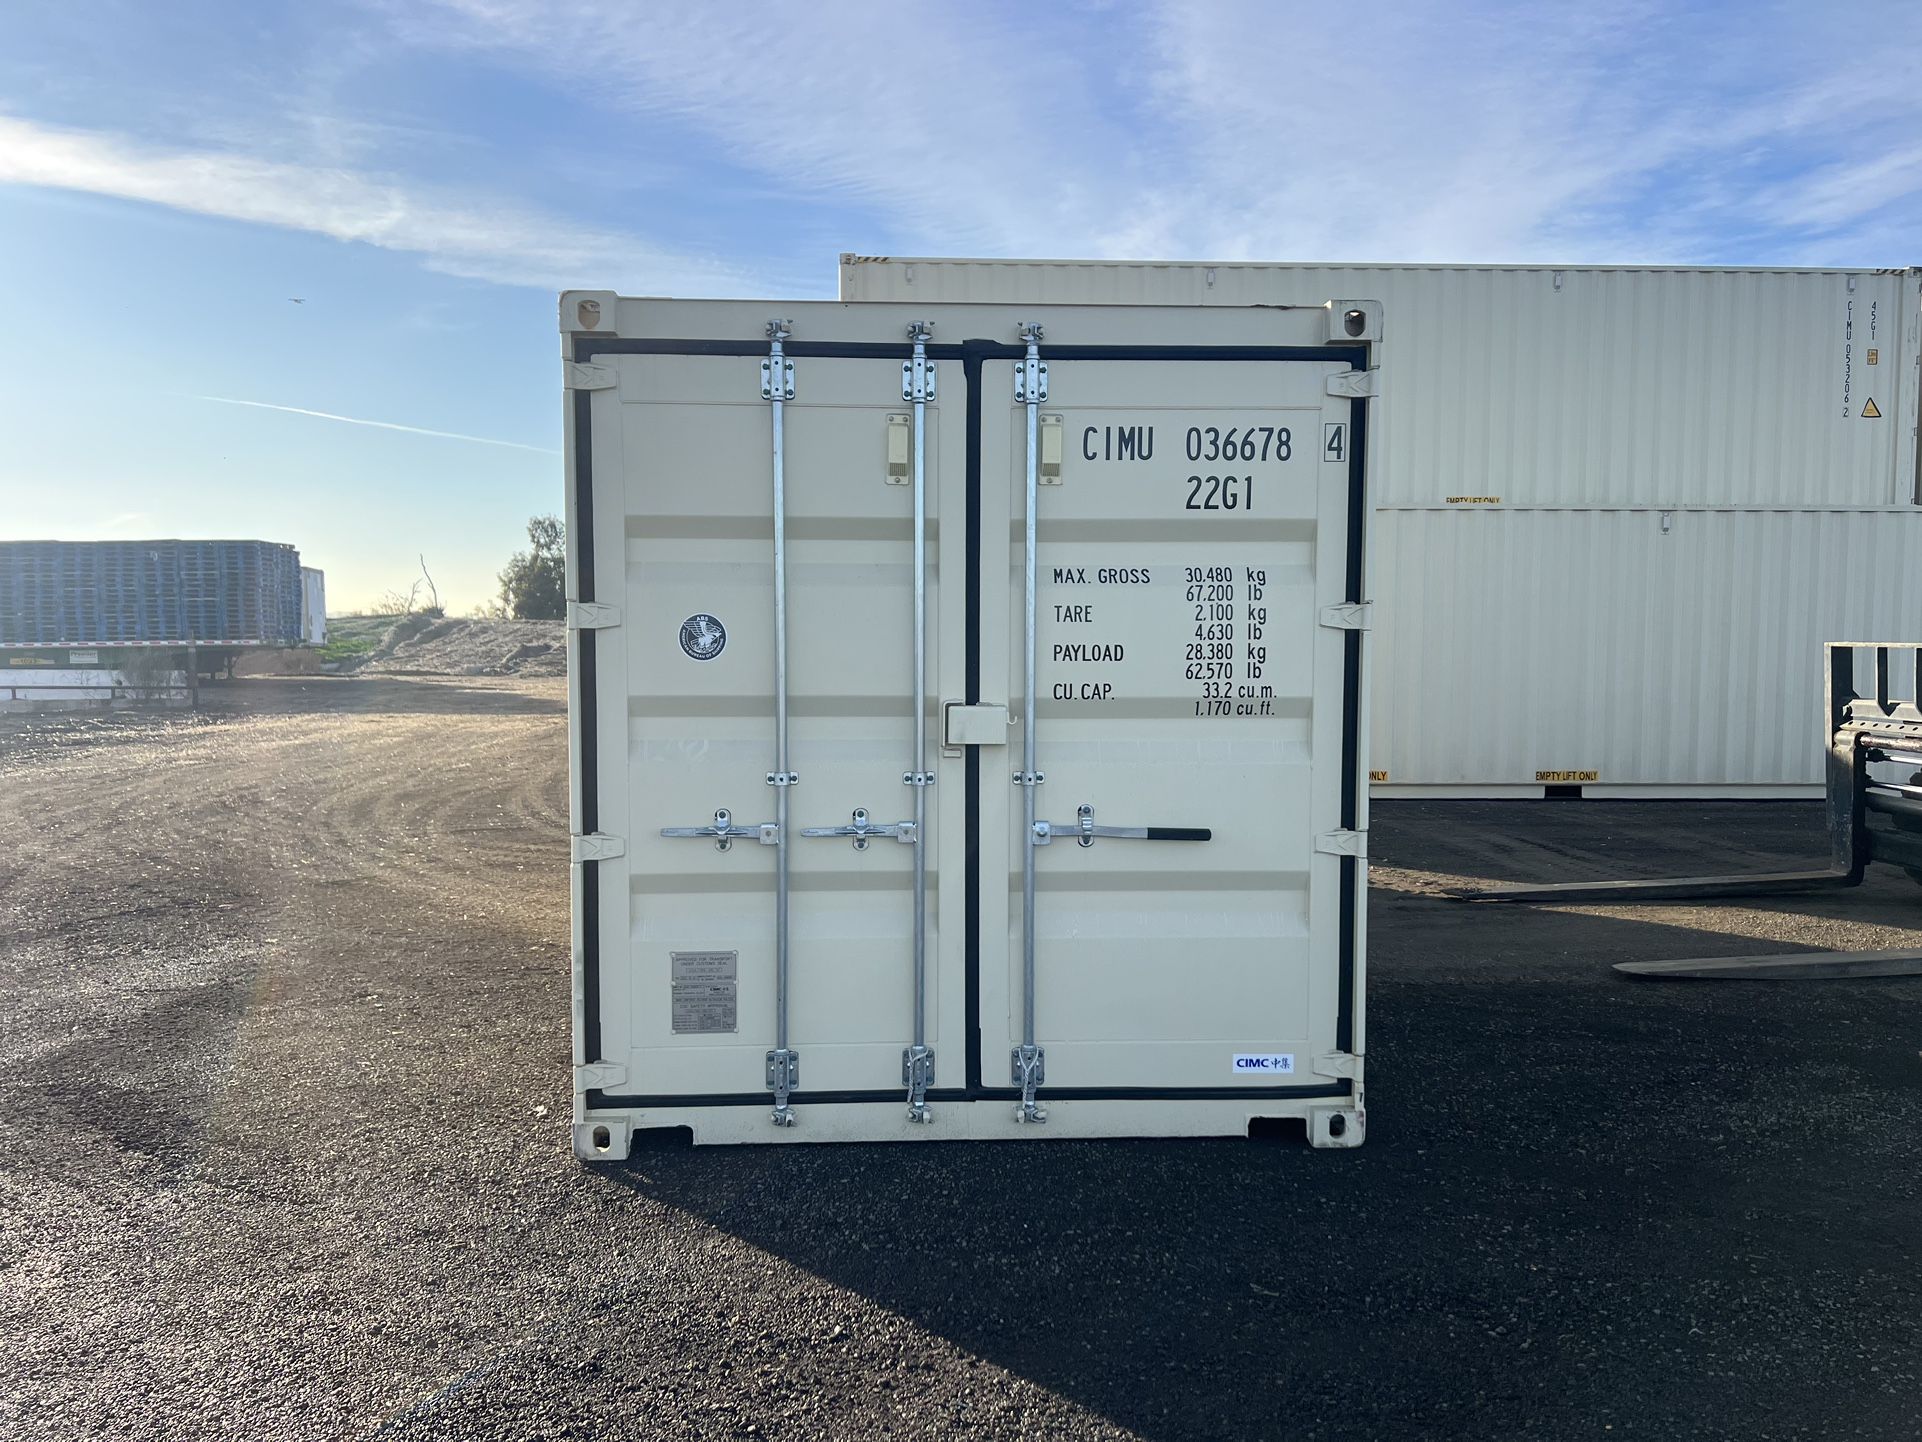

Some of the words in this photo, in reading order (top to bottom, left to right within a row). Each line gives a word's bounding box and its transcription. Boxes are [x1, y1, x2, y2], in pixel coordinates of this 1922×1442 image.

[1082, 426, 1154, 461] CIMU
[1186, 426, 1292, 461] 036678
[1327, 425, 1343, 460] 4
[1185, 475, 1253, 510] 22G1
[1053, 568, 1092, 584] MAX.
[1098, 568, 1151, 584] GROSS
[1246, 566, 1266, 586] kg
[1247, 584, 1263, 601] lb
[1054, 605, 1093, 623] TARE
[1248, 603, 1267, 625] kg
[1247, 623, 1263, 640] lb
[1053, 644, 1124, 662] PAYLOAD
[1247, 642, 1266, 664] kg
[1247, 661, 1263, 679] lb
[1202, 681, 1233, 699] 33.2
[1535, 771, 1561, 781] EMPTY
[1562, 771, 1578, 781] LIFT
[1578, 771, 1598, 781] ONLY
[1236, 1058, 1270, 1068] CIMC
